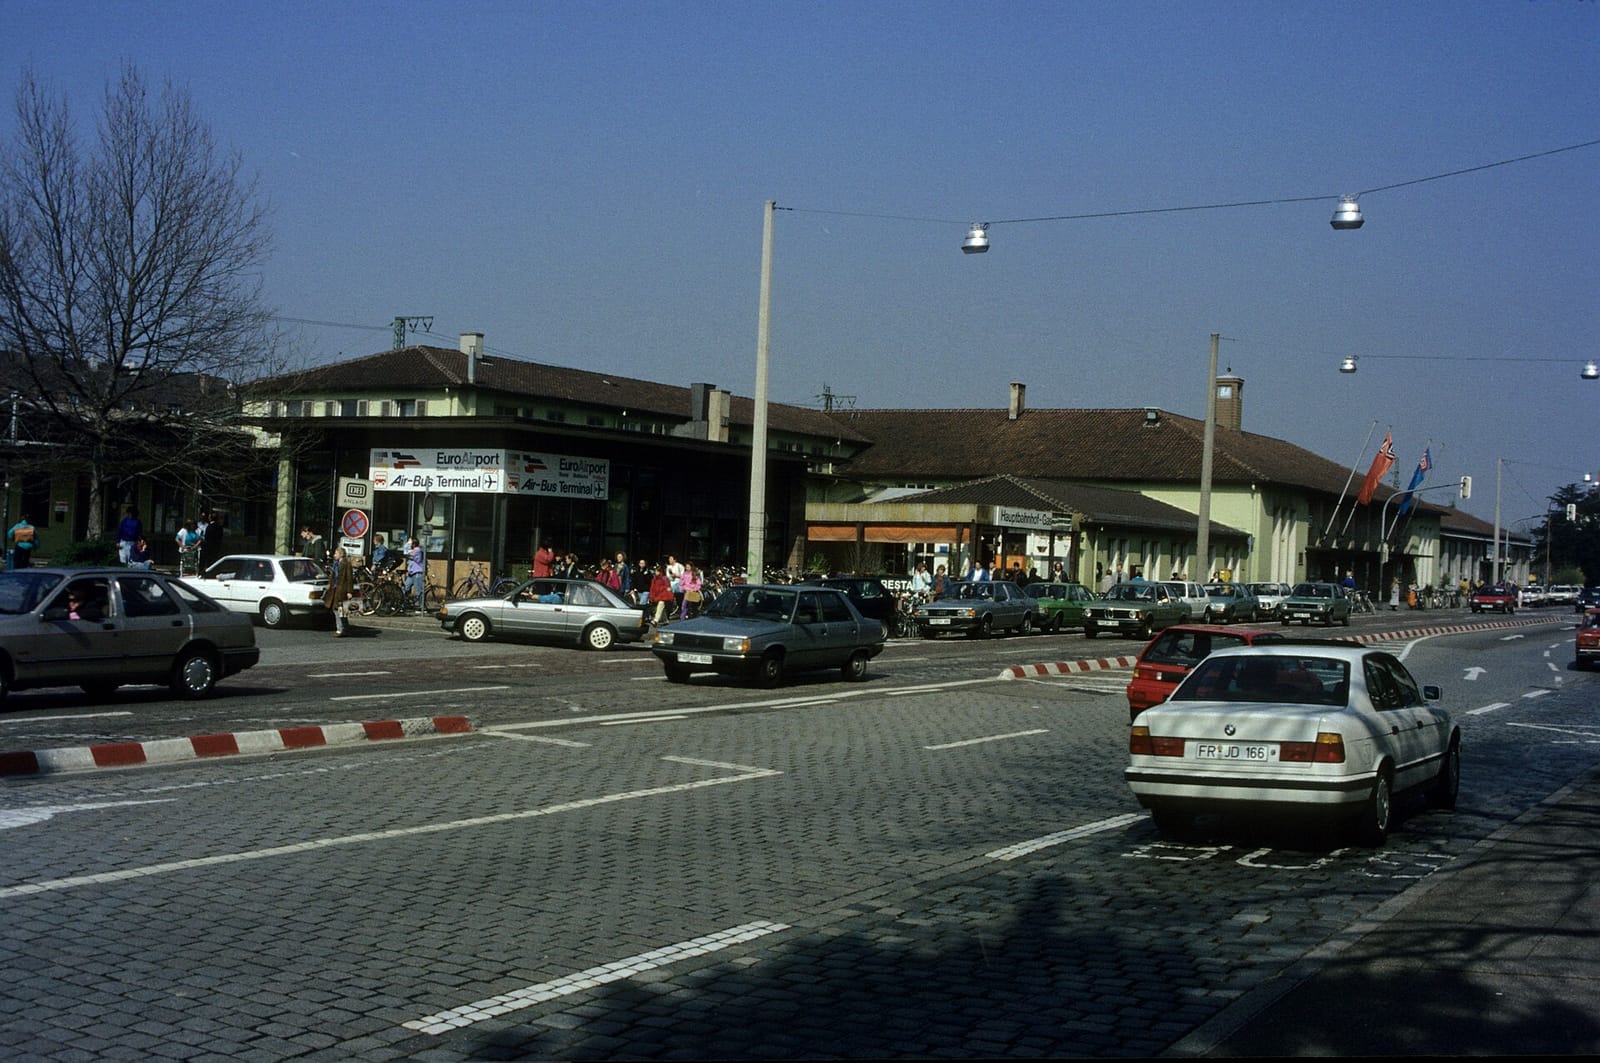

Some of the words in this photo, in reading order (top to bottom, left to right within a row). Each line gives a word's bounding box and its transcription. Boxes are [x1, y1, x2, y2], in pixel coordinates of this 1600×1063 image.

[436, 452, 500, 467] EuroAirport
[559, 458, 606, 475] EuroAirport
[390, 474, 434, 488] Air-Bus
[436, 475, 481, 488] Terminal
[521, 477, 558, 492] Air-Bus
[559, 480, 593, 495] Terminal
[1198, 745, 1216, 758] FR
[1224, 746, 1240, 758] JD
[1246, 746, 1265, 759] 166
